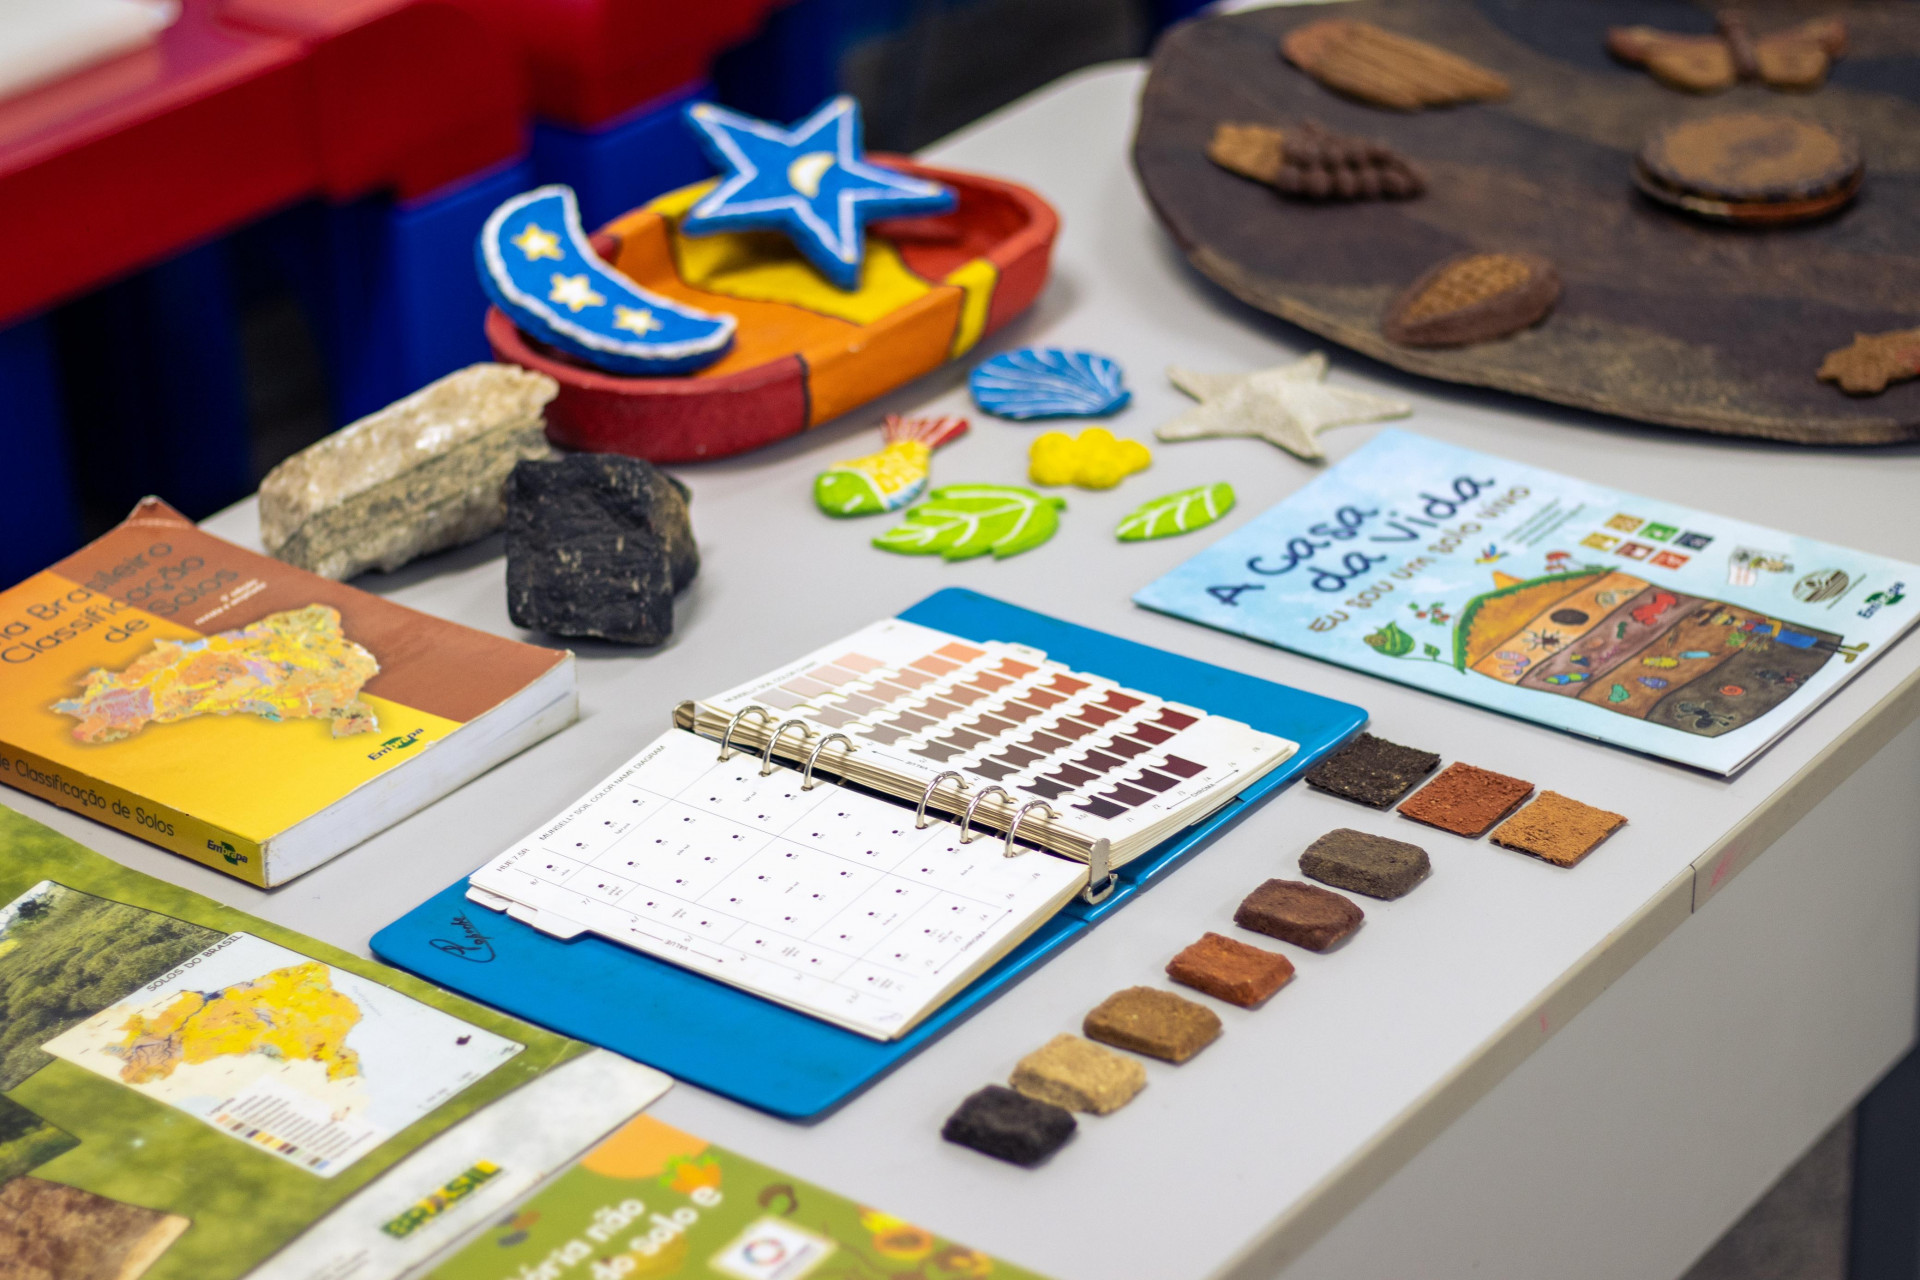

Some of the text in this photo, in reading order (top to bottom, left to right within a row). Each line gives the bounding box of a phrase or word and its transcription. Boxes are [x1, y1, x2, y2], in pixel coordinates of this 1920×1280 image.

[1205, 505, 1379, 606] A Casa
[1307, 551, 1388, 592] da
[1369, 476, 1495, 542] Vida
[0, 542, 173, 640] a Brasileiro
[1, 556, 205, 663] Classificação
[105, 568, 239, 643] de Solos
[367, 728, 424, 761] Embrapa
[590, 784, 617, 803] COLOR
[613, 769, 636, 785] NAME
[633, 745, 667, 769] DIAGRAM
[15, 759, 107, 810] Classificação
[112, 799, 130, 818] de
[136, 807, 175, 837] Solos
[207, 839, 248, 864] Embrapa
[496, 858, 514, 873] HUE
[146, 934, 244, 992] SOLOS DO BRASIL
[586, 1198, 645, 1243] não
[629, 1206, 699, 1256] solo
[689, 1185, 724, 1208] e
